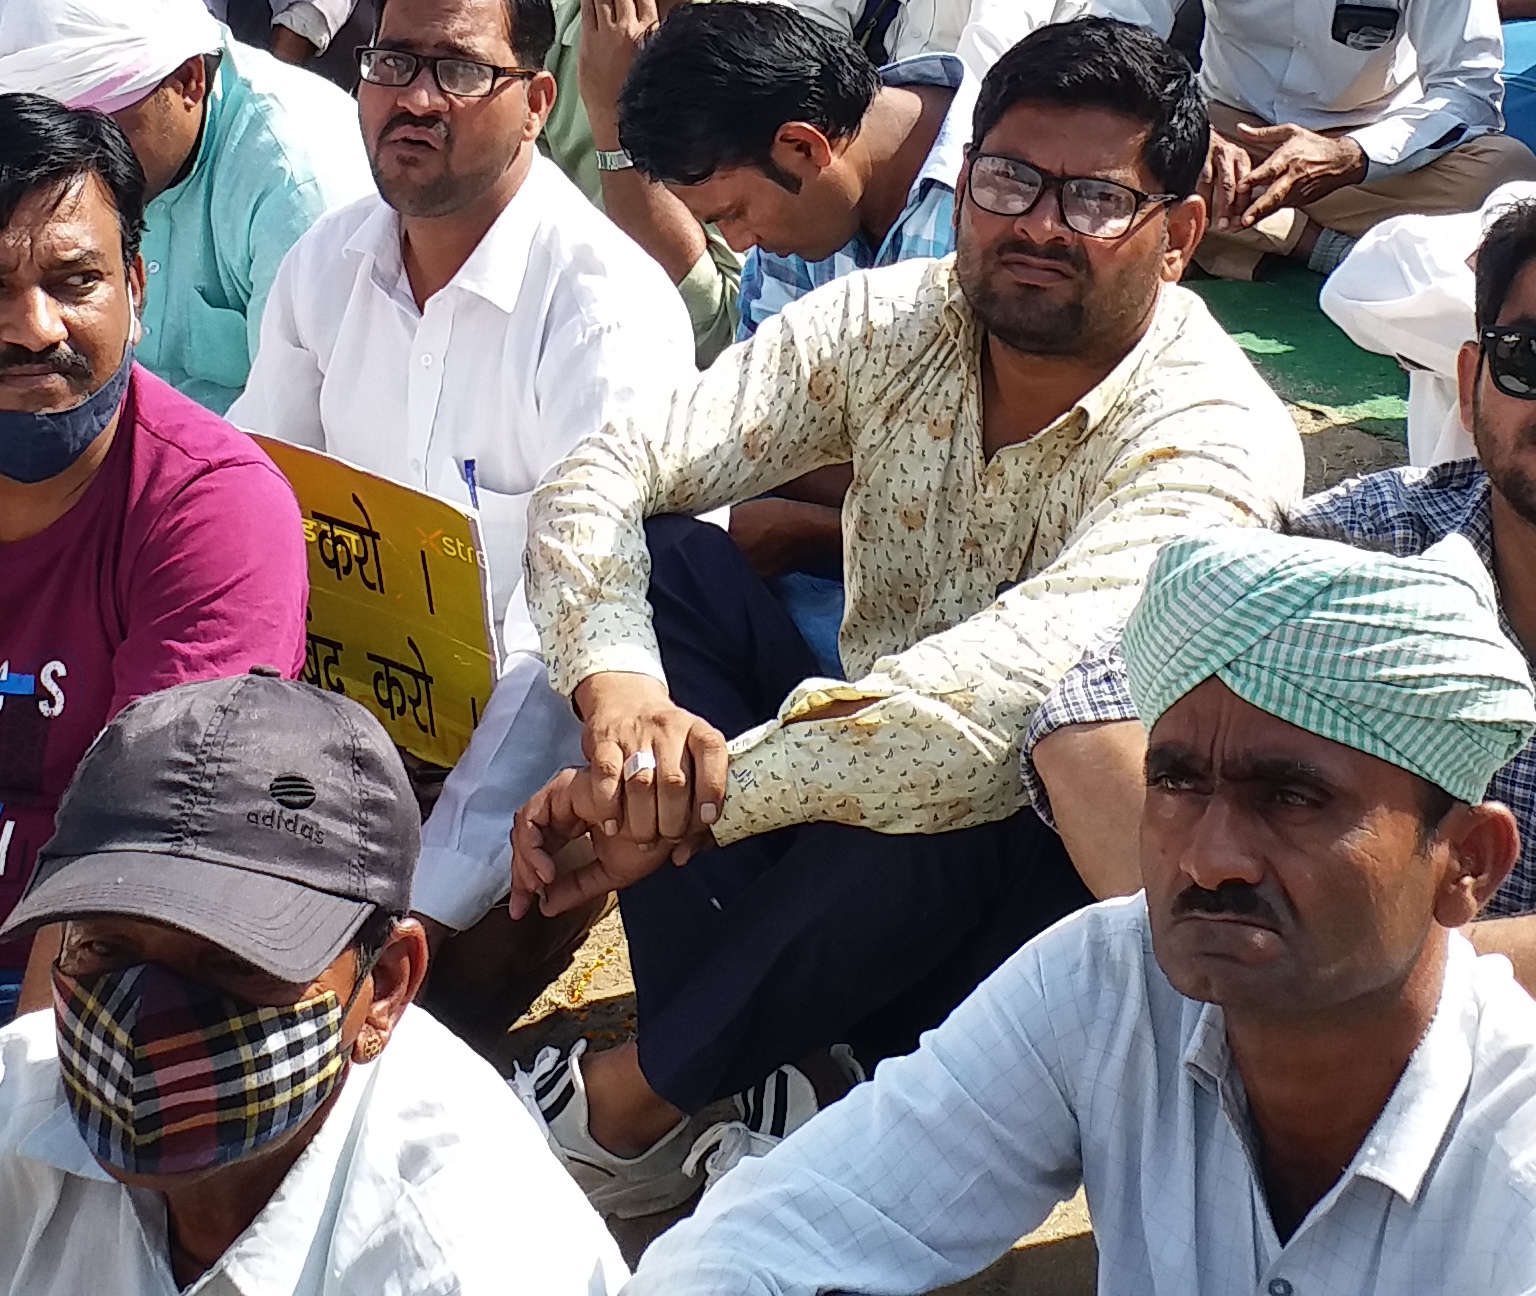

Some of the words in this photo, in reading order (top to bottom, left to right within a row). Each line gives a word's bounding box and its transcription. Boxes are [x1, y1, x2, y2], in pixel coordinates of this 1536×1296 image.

[311, 492, 385, 595] करो
[366, 636, 436, 738] करो
[246, 808, 325, 845] adidas
